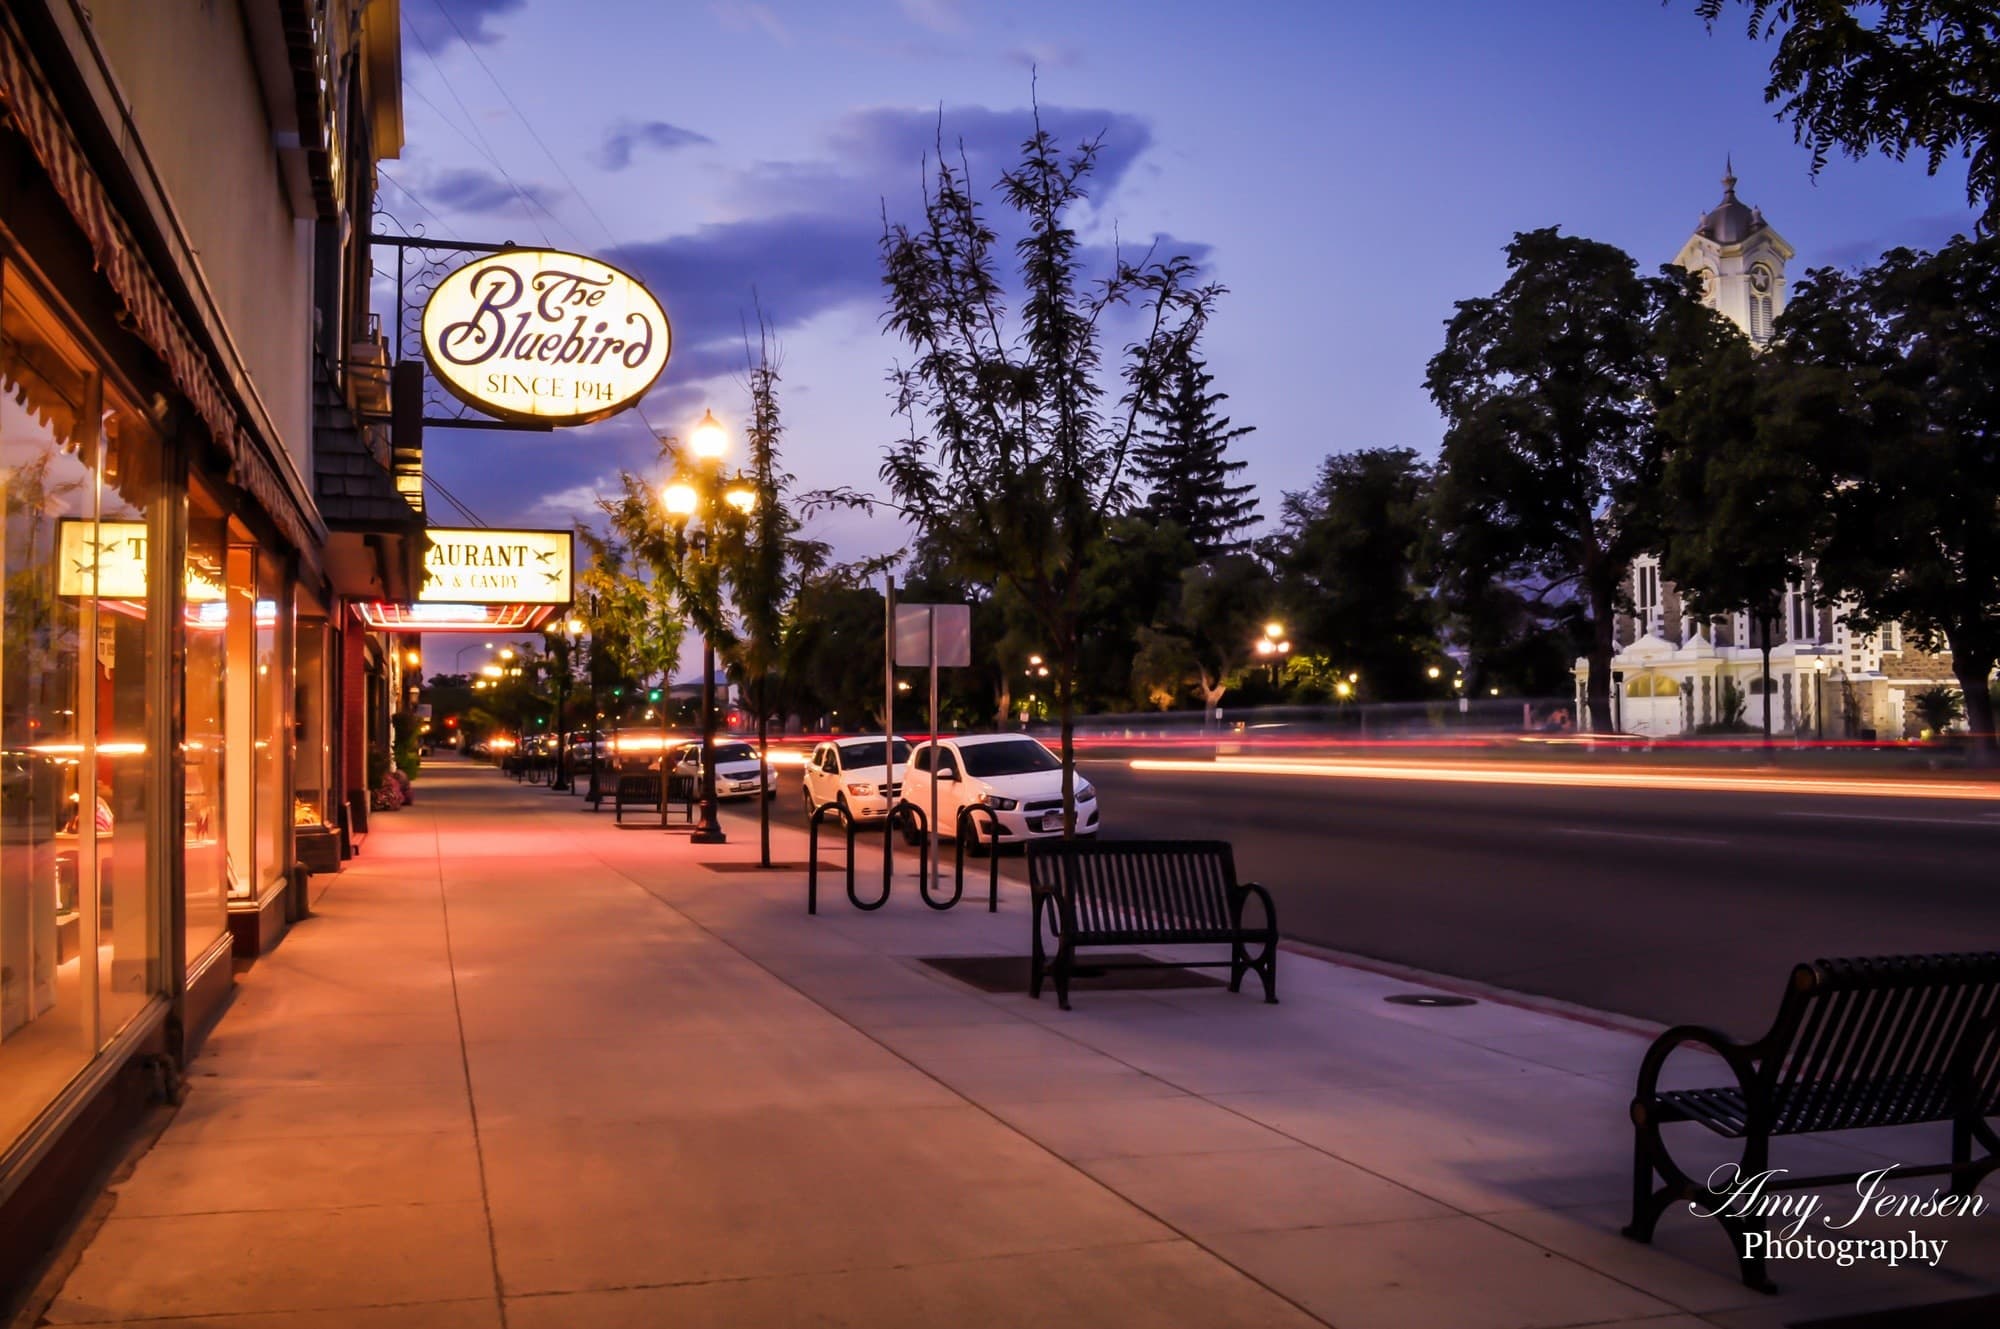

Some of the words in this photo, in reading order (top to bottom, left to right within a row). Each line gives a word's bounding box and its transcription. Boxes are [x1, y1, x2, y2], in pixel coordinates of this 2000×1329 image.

[532, 270, 614, 322] The
[438, 265, 653, 369] Bluebird
[486, 374, 564, 397] SINCE
[574, 380, 614, 401] 1914
[470, 575, 519, 588] CANDY
